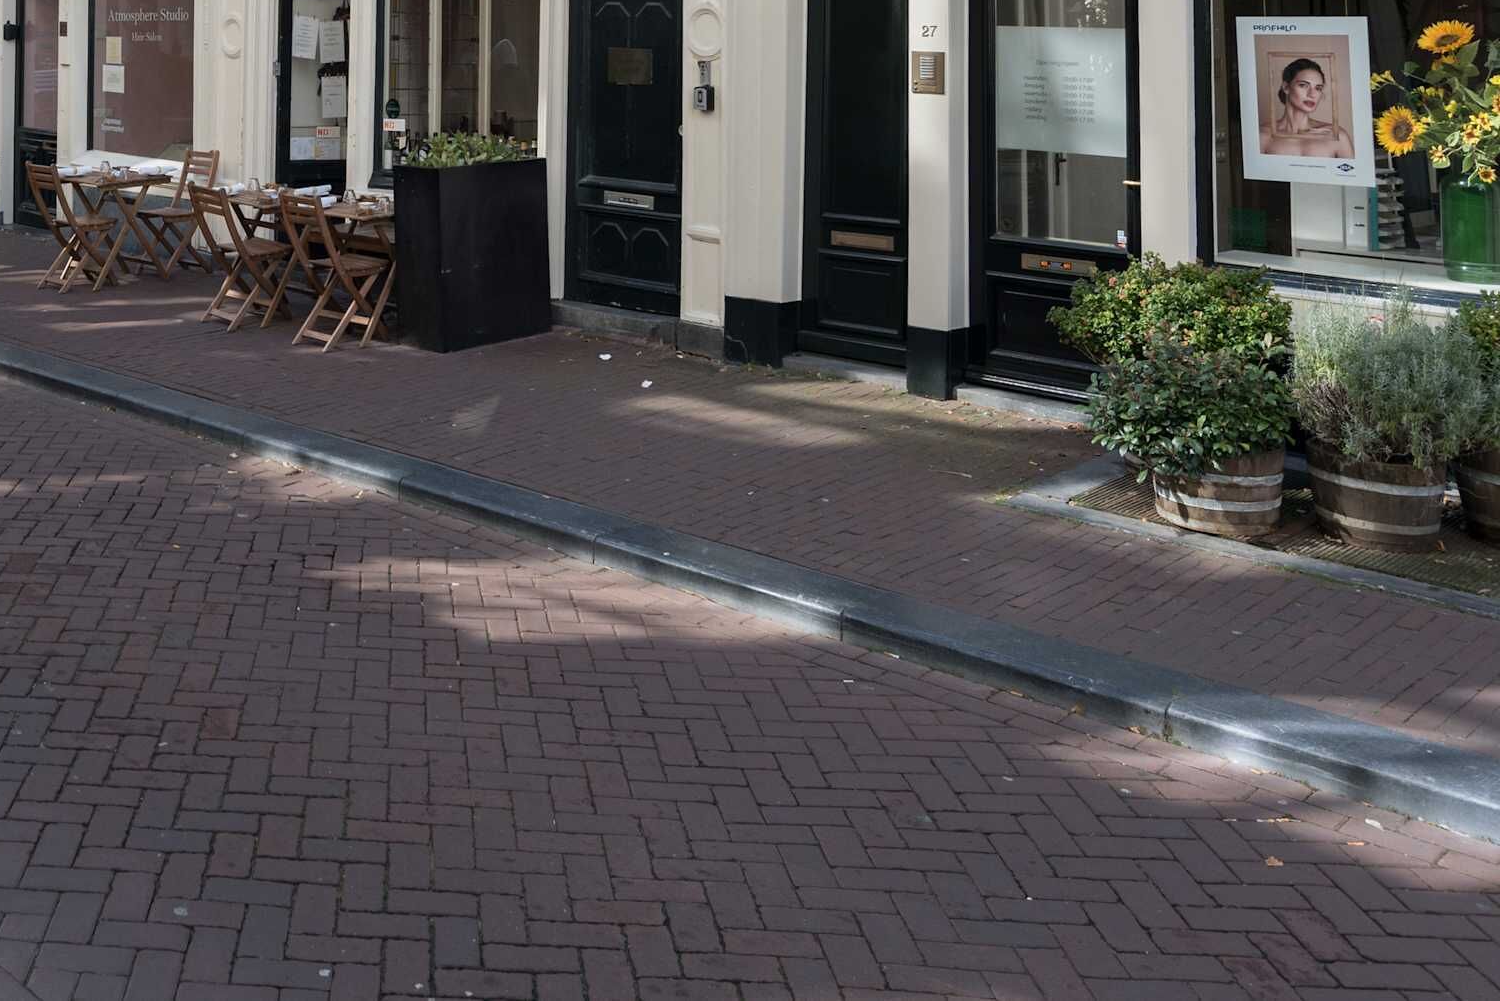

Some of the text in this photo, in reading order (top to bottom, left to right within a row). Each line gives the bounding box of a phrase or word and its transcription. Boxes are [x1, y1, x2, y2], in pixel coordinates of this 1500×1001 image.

[108, 7, 189, 26] Atmosphere Studio
[921, 25, 938, 38] 27
